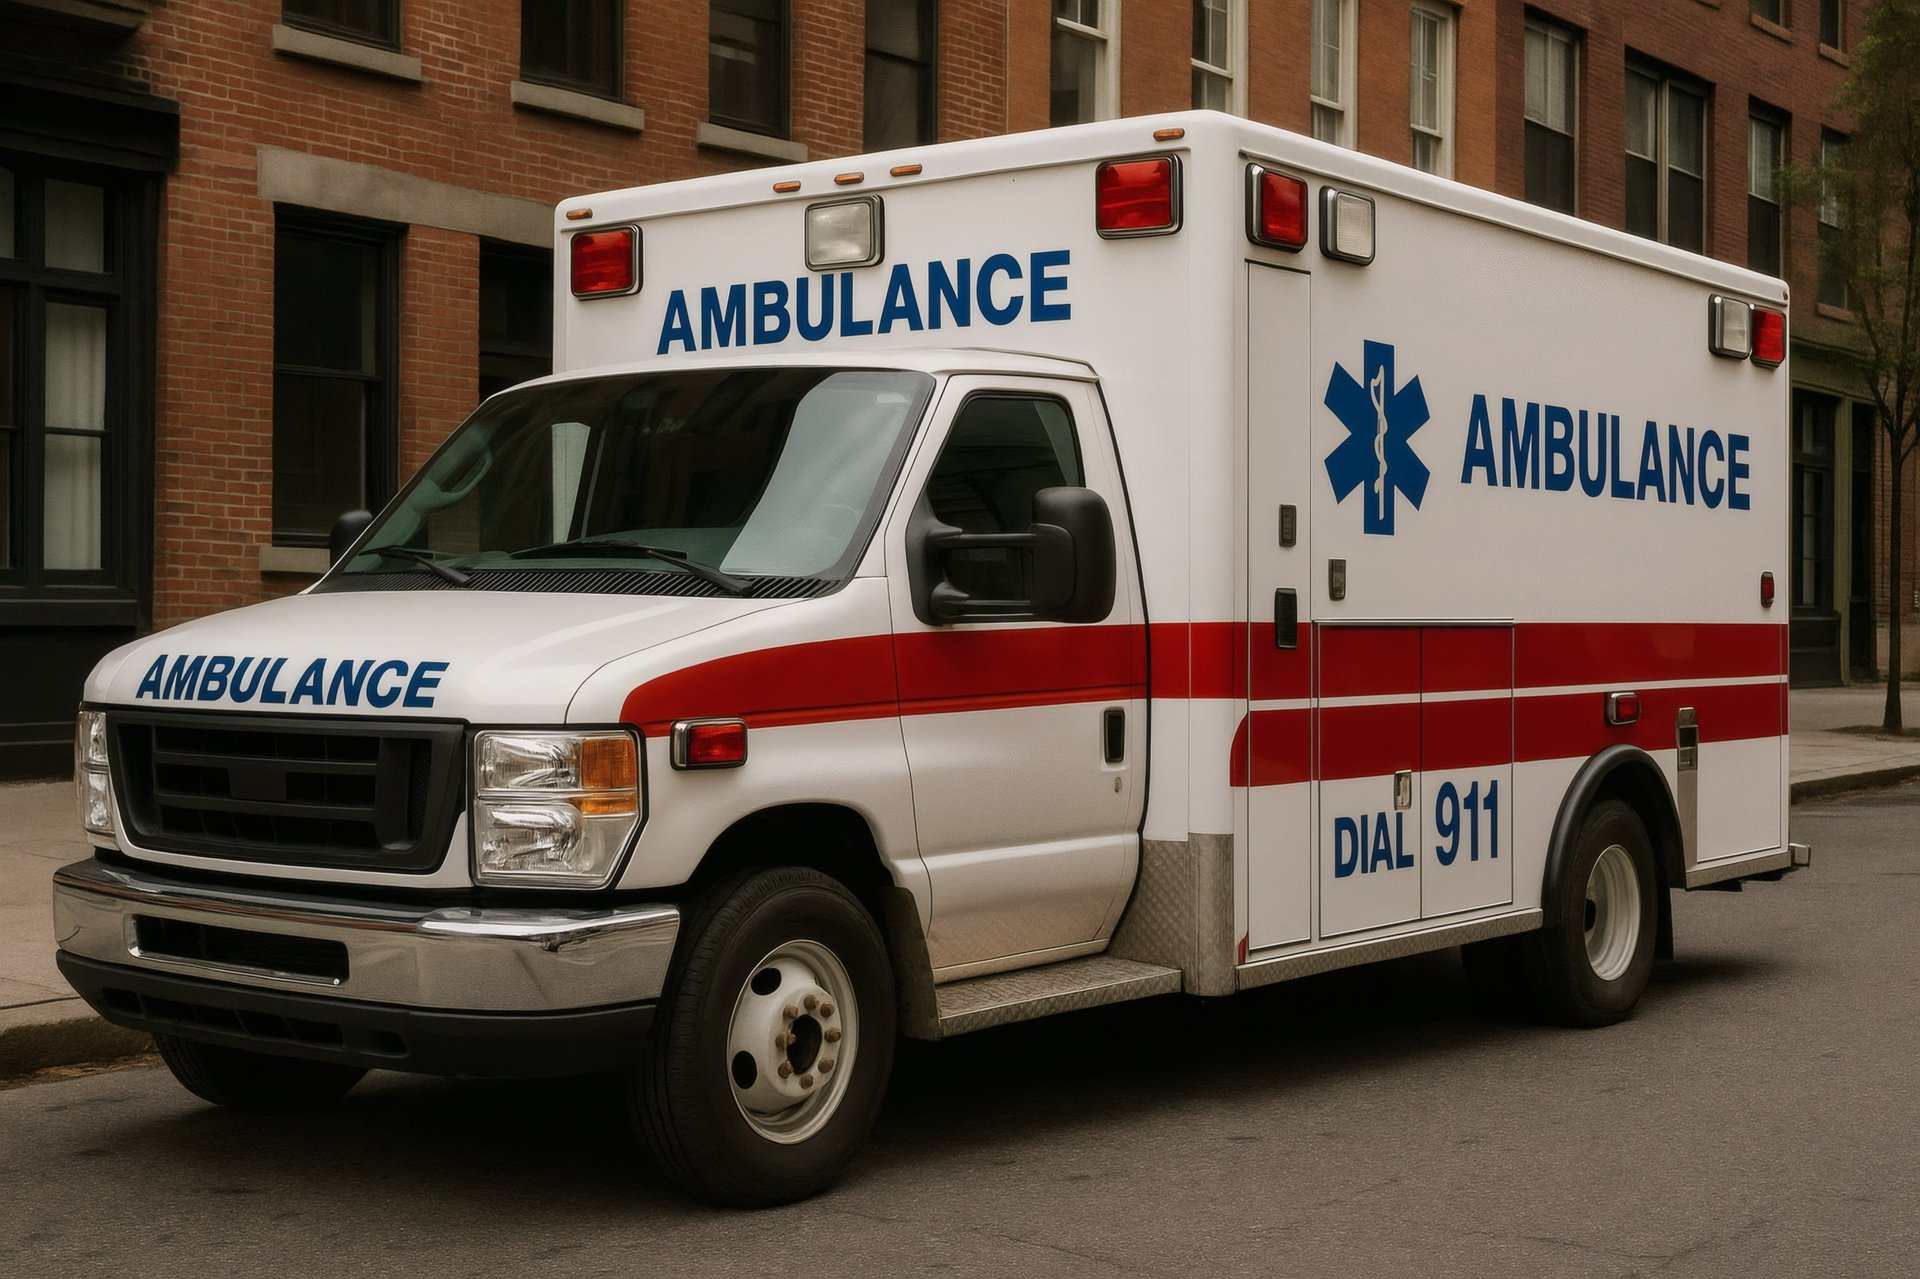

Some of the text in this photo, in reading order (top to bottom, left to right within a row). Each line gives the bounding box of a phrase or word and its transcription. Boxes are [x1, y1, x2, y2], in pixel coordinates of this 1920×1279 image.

[657, 249, 1071, 355] AMBULANCE
[1461, 394, 1751, 511] AMBULANCE
[136, 654, 449, 708] AMBULANCE
[1335, 780, 1498, 879] DIAL 911
